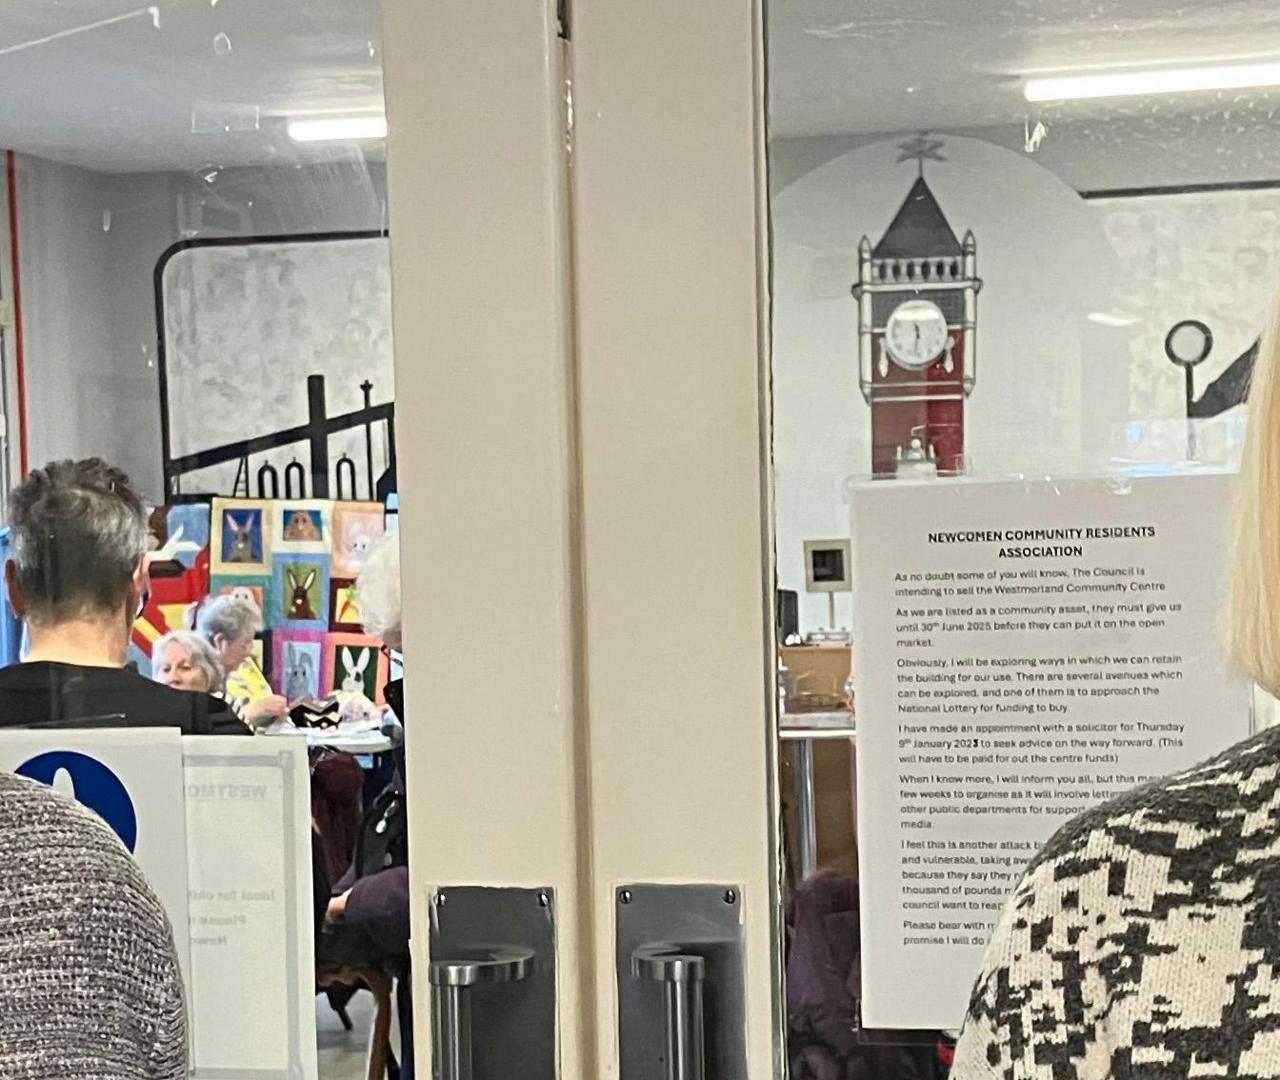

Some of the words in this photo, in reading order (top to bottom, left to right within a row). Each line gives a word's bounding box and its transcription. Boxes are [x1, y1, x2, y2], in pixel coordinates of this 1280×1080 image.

[927, 530, 1002, 543] NEWCOMEN
[1004, 528, 1083, 541] COMMUNITY
[1085, 526, 1155, 538] RESIDENTS
[997, 545, 1083, 558] ASSOCIATION
